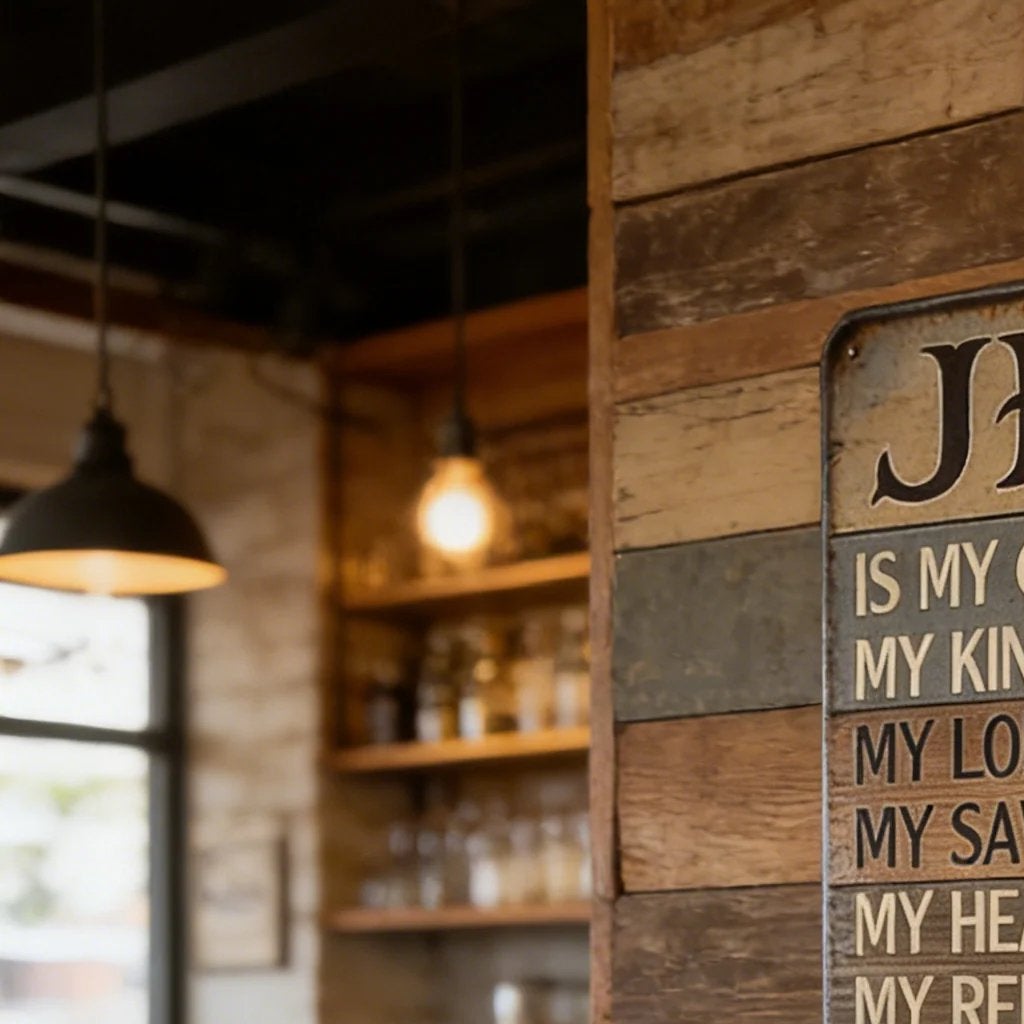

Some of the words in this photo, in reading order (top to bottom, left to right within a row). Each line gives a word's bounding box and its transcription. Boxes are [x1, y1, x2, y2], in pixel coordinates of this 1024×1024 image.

[855, 551, 901, 616] IS
[920, 539, 999, 610] MY
[855, 633, 935, 700] MY
[856, 719, 935, 785] MY
[856, 804, 934, 868] MY
[855, 890, 934, 956] MY
